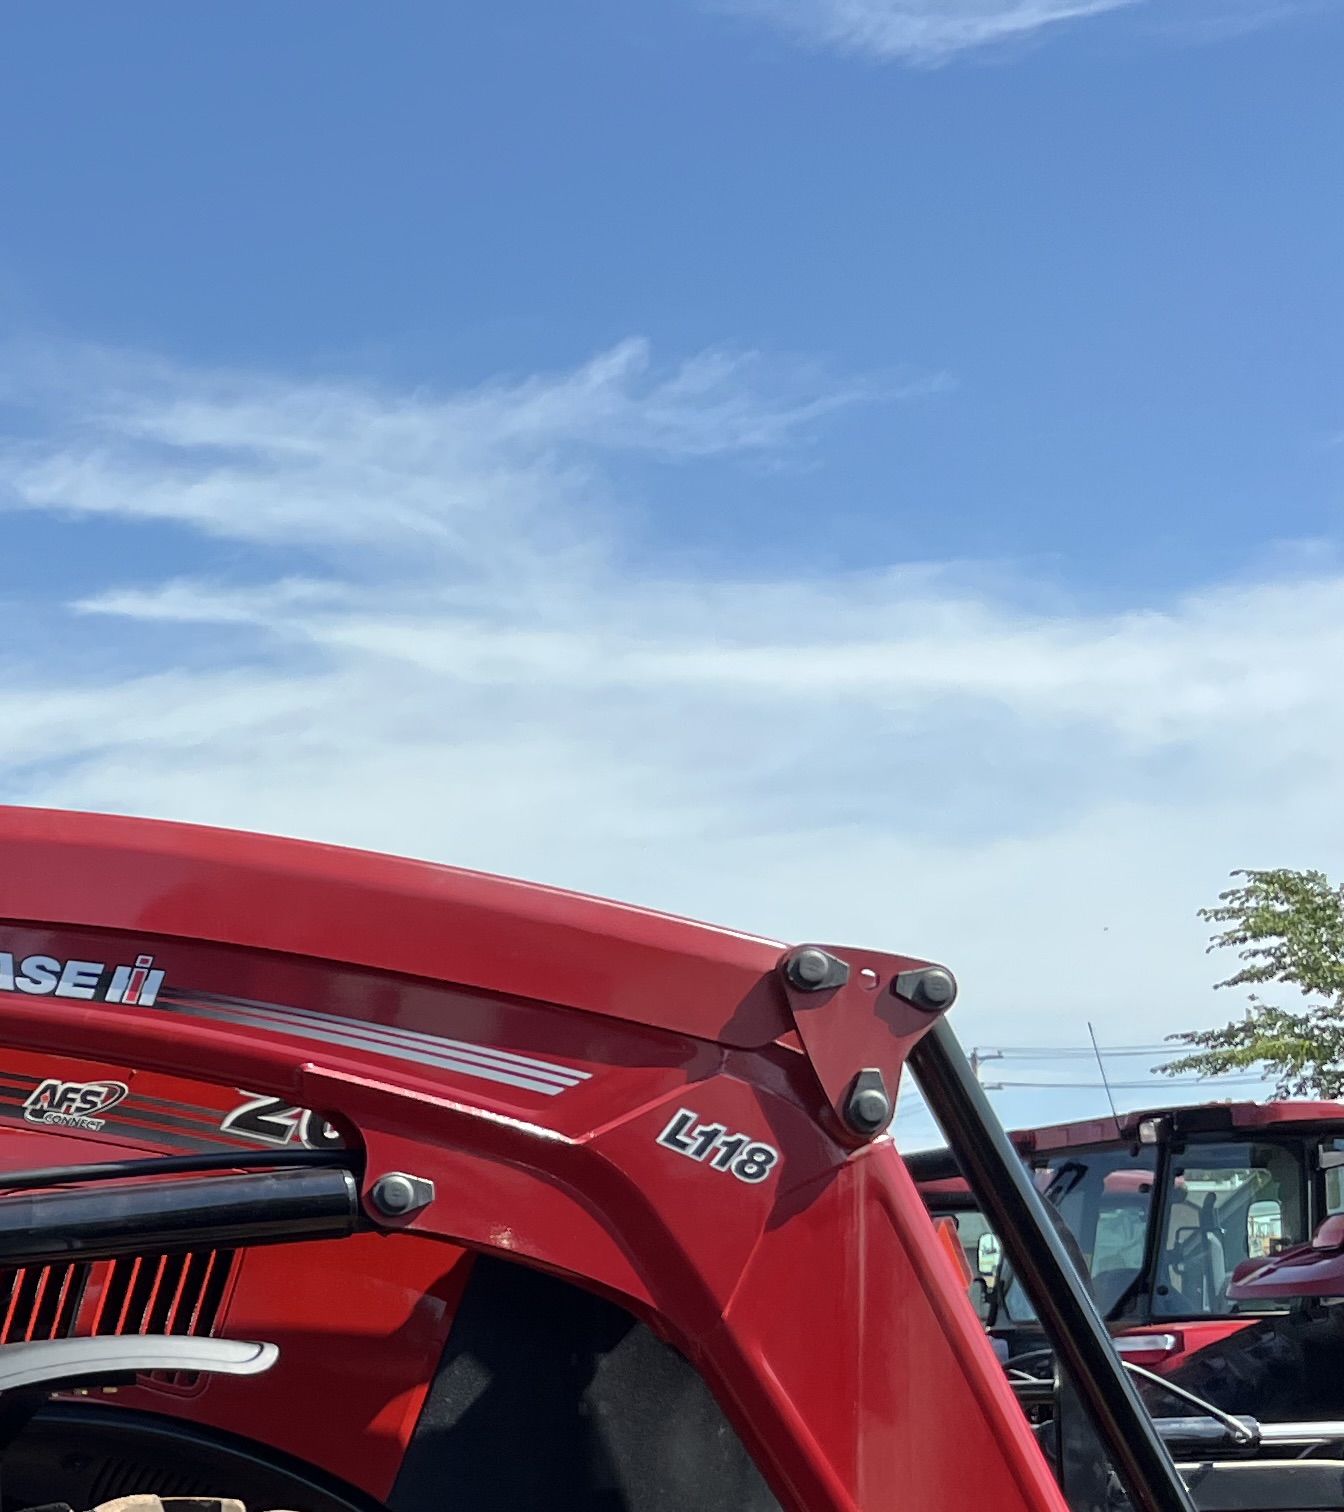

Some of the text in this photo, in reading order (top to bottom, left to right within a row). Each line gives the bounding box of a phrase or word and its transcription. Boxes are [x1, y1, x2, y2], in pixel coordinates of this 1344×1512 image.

[22, 1079, 109, 1115] AFS
[43, 1112, 105, 1131] CONNECT
[656, 1107, 779, 1184] L118
